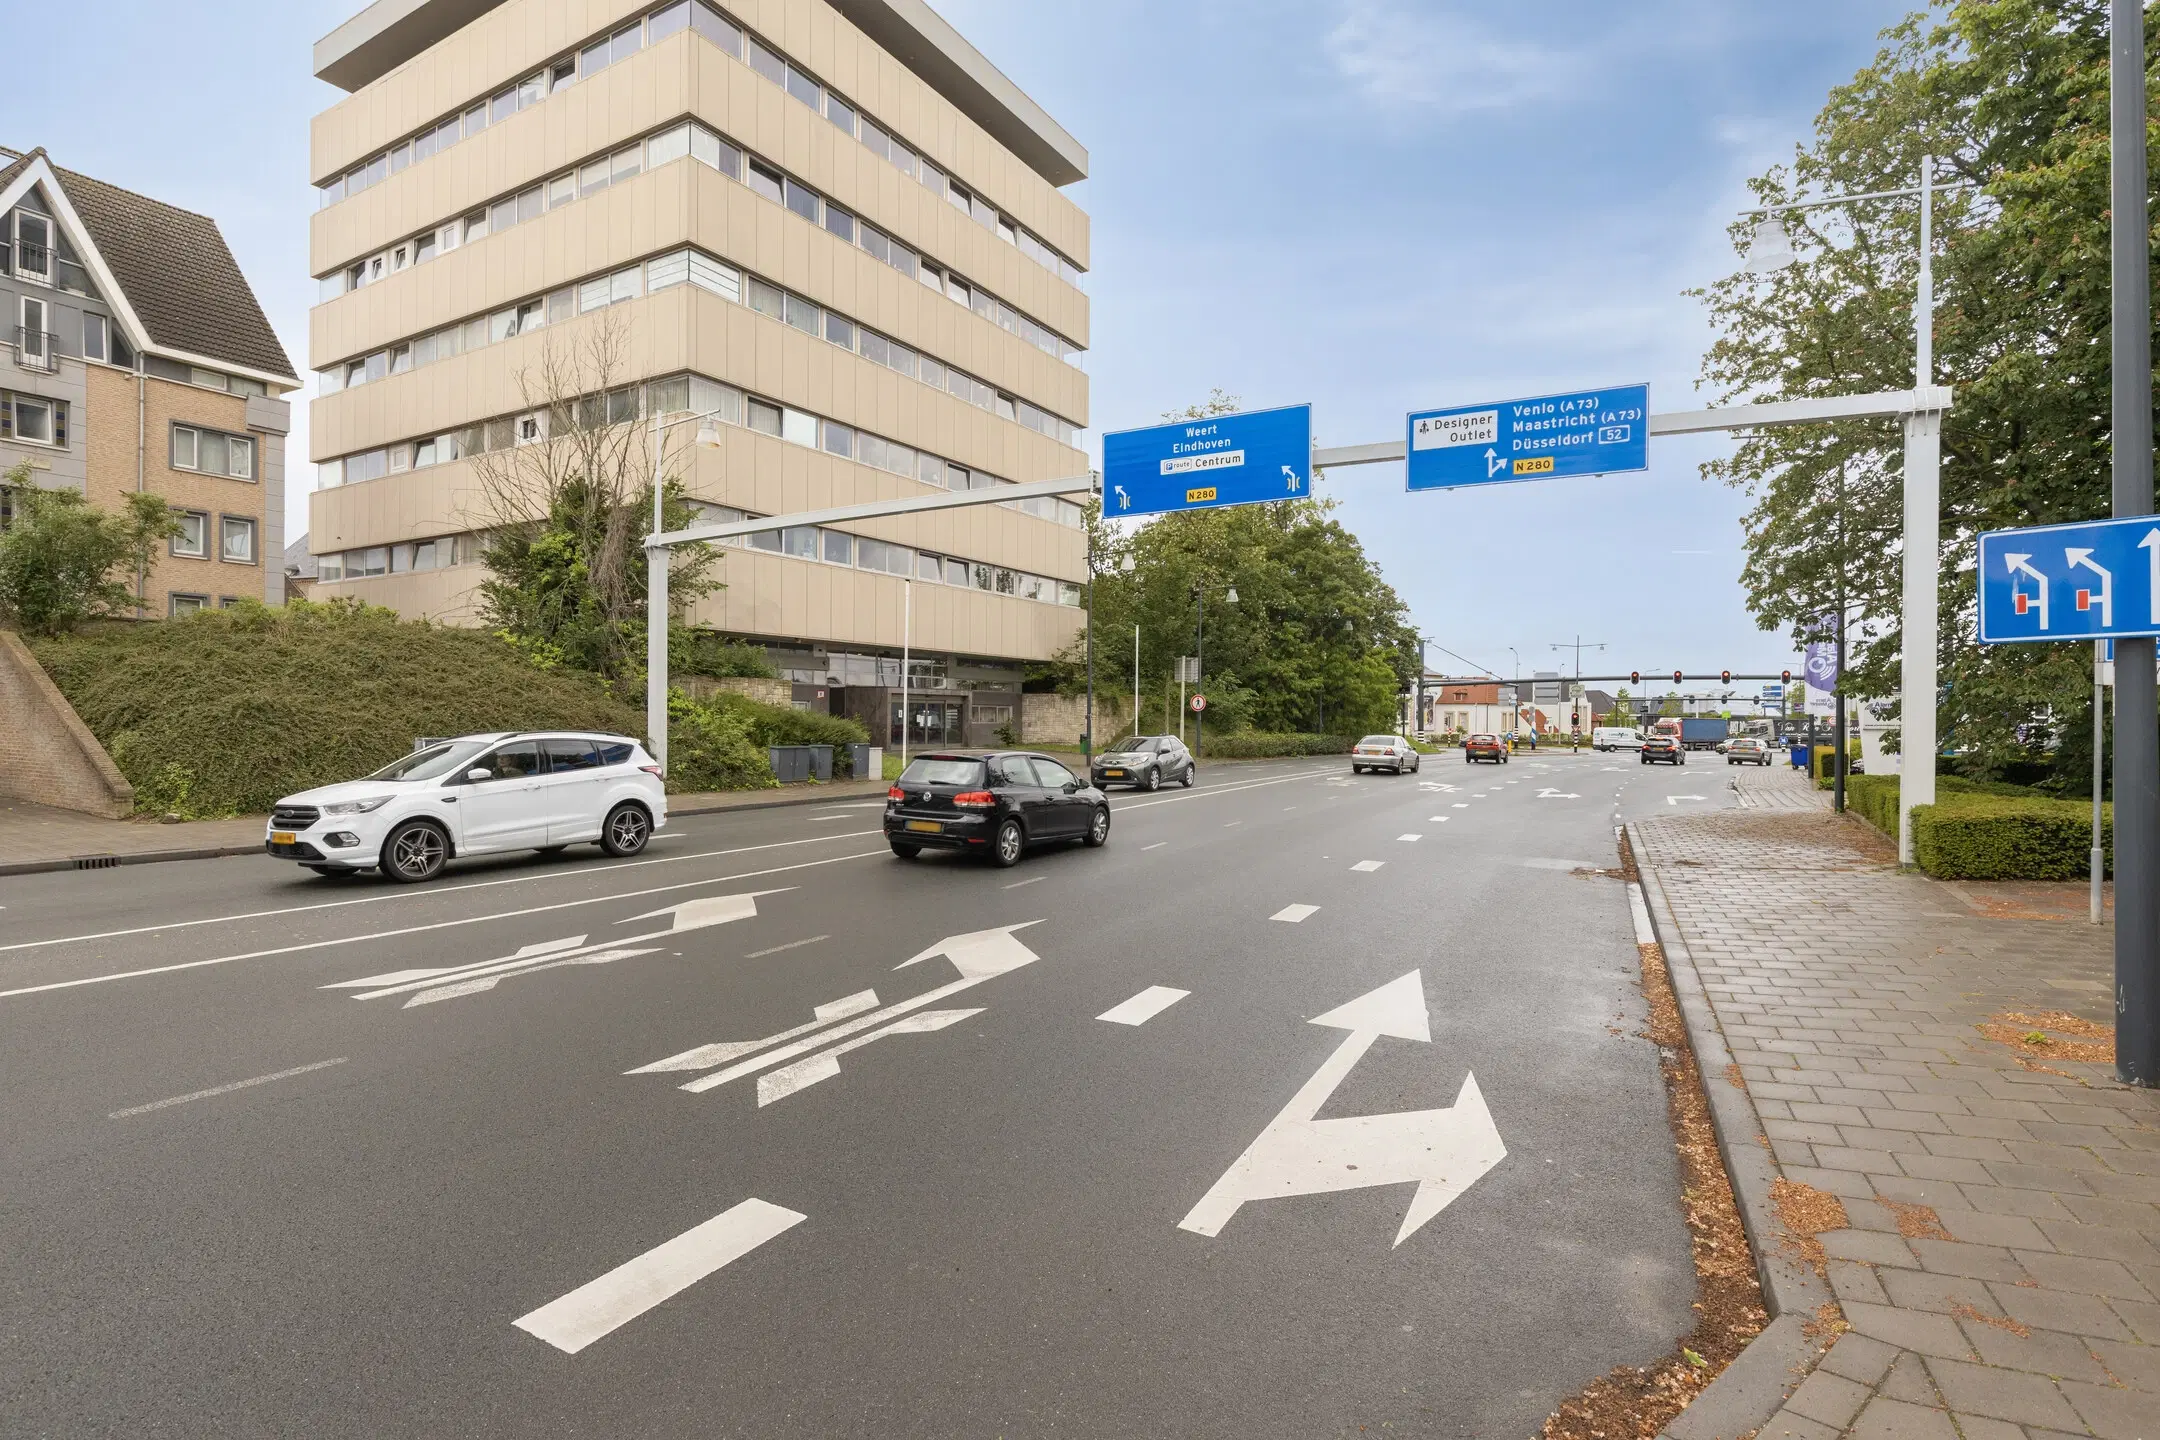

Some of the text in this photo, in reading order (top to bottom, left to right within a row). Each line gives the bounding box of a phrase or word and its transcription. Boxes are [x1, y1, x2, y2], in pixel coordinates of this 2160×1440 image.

[1513, 402, 1555, 417] Venlo
[1434, 414, 1493, 430] Designer
[1513, 412, 1596, 433] Maastricht
[1185, 424, 1218, 438] Weert
[1450, 429, 1493, 443] Outlet
[1173, 438, 1231, 454] Eindhoven
[1513, 428, 1622, 452] Düsseldorf 52
[1173, 461, 1190, 469] route
[1195, 455, 1241, 468] Centrum
